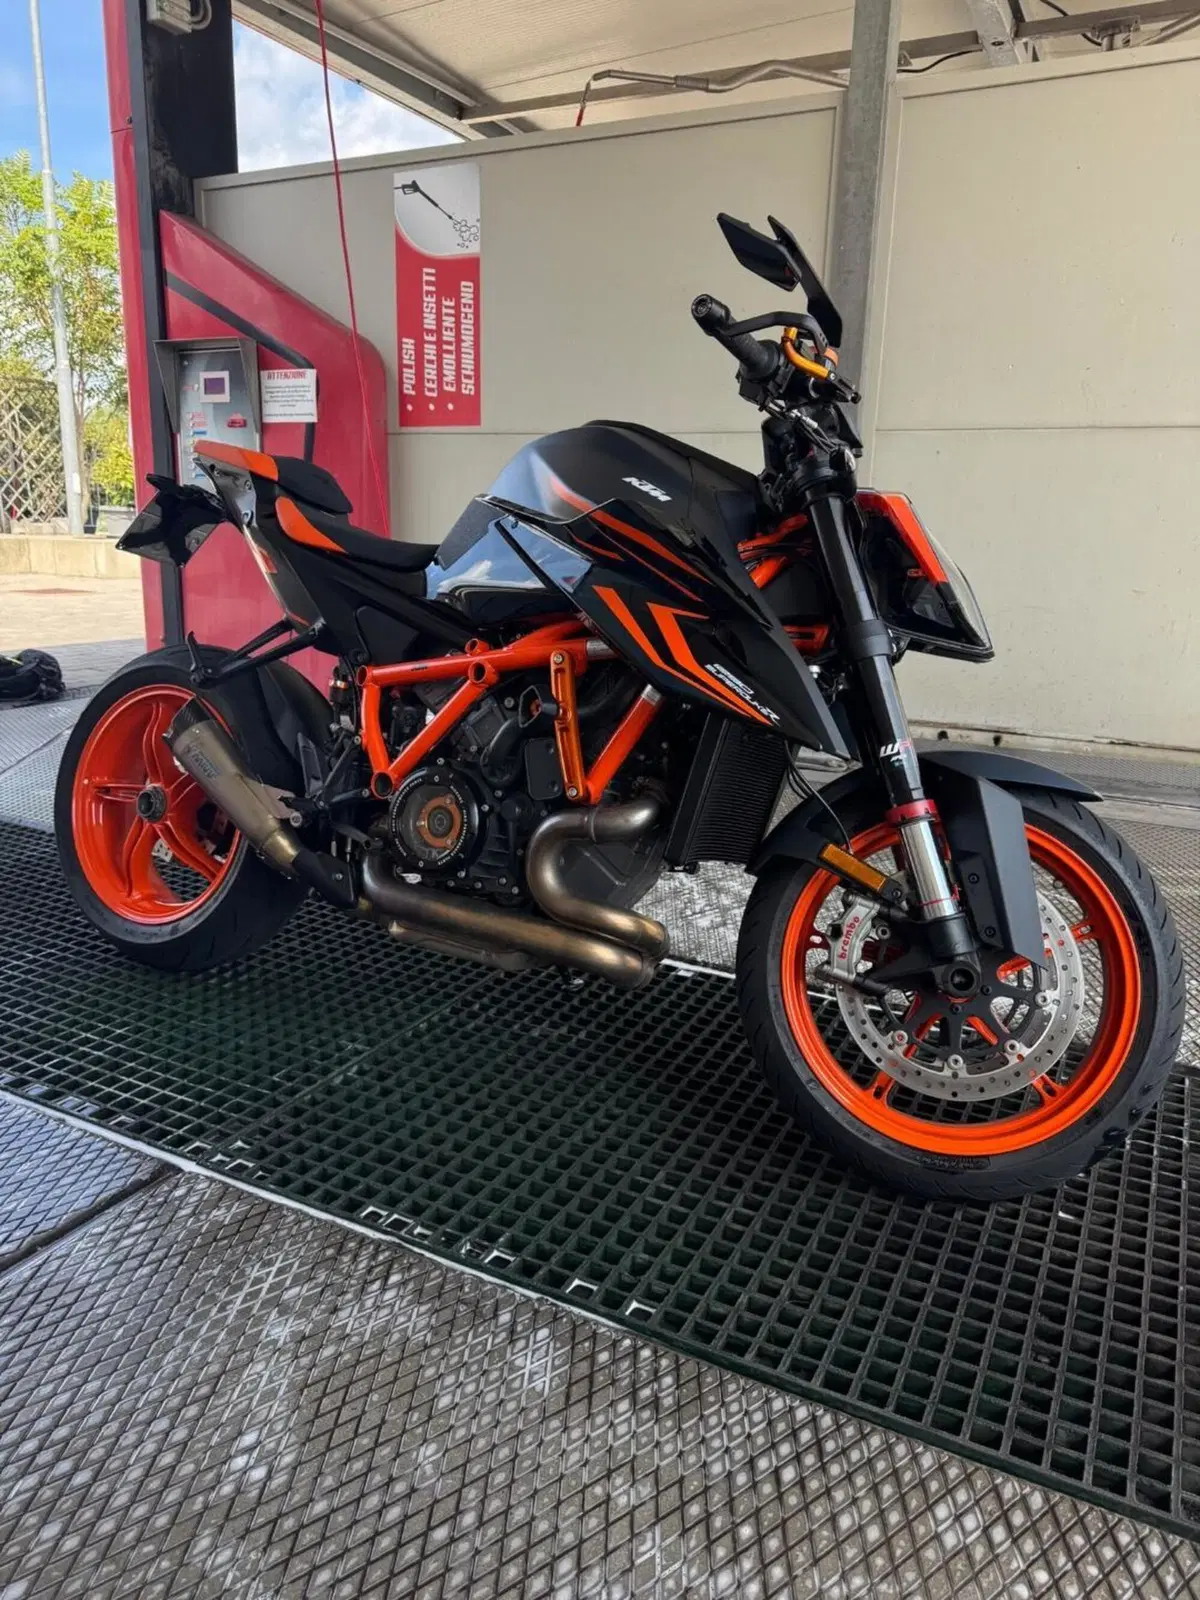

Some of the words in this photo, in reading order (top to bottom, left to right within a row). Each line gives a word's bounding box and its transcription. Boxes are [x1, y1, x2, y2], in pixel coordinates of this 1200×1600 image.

[422, 267, 437, 330] INSETTI
[423, 330, 437, 342] E
[442, 296, 456, 392] EMOLLIENTE
[461, 281, 475, 396] SCHIUMOGENO
[402, 337, 416, 396] POLISH
[424, 343, 438, 397] CERCHI
[621, 476, 673, 502] KTM
[838, 916, 860, 960] brembo
